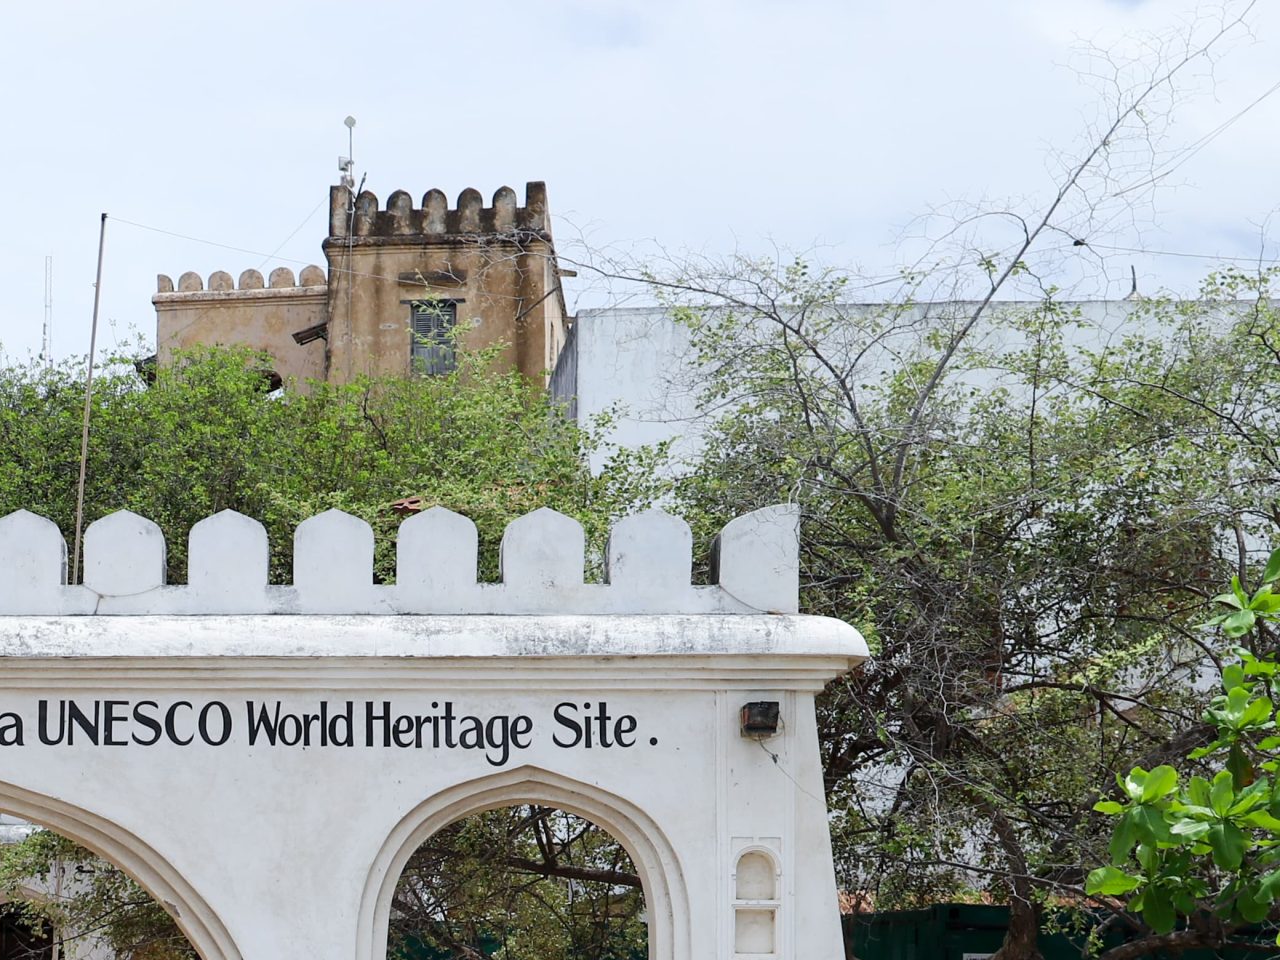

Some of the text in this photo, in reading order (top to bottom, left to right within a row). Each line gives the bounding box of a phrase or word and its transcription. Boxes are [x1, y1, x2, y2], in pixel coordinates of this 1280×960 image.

[37, 699, 232, 746] UNESCO
[246, 699, 354, 748] World
[365, 700, 532, 767] Heritage
